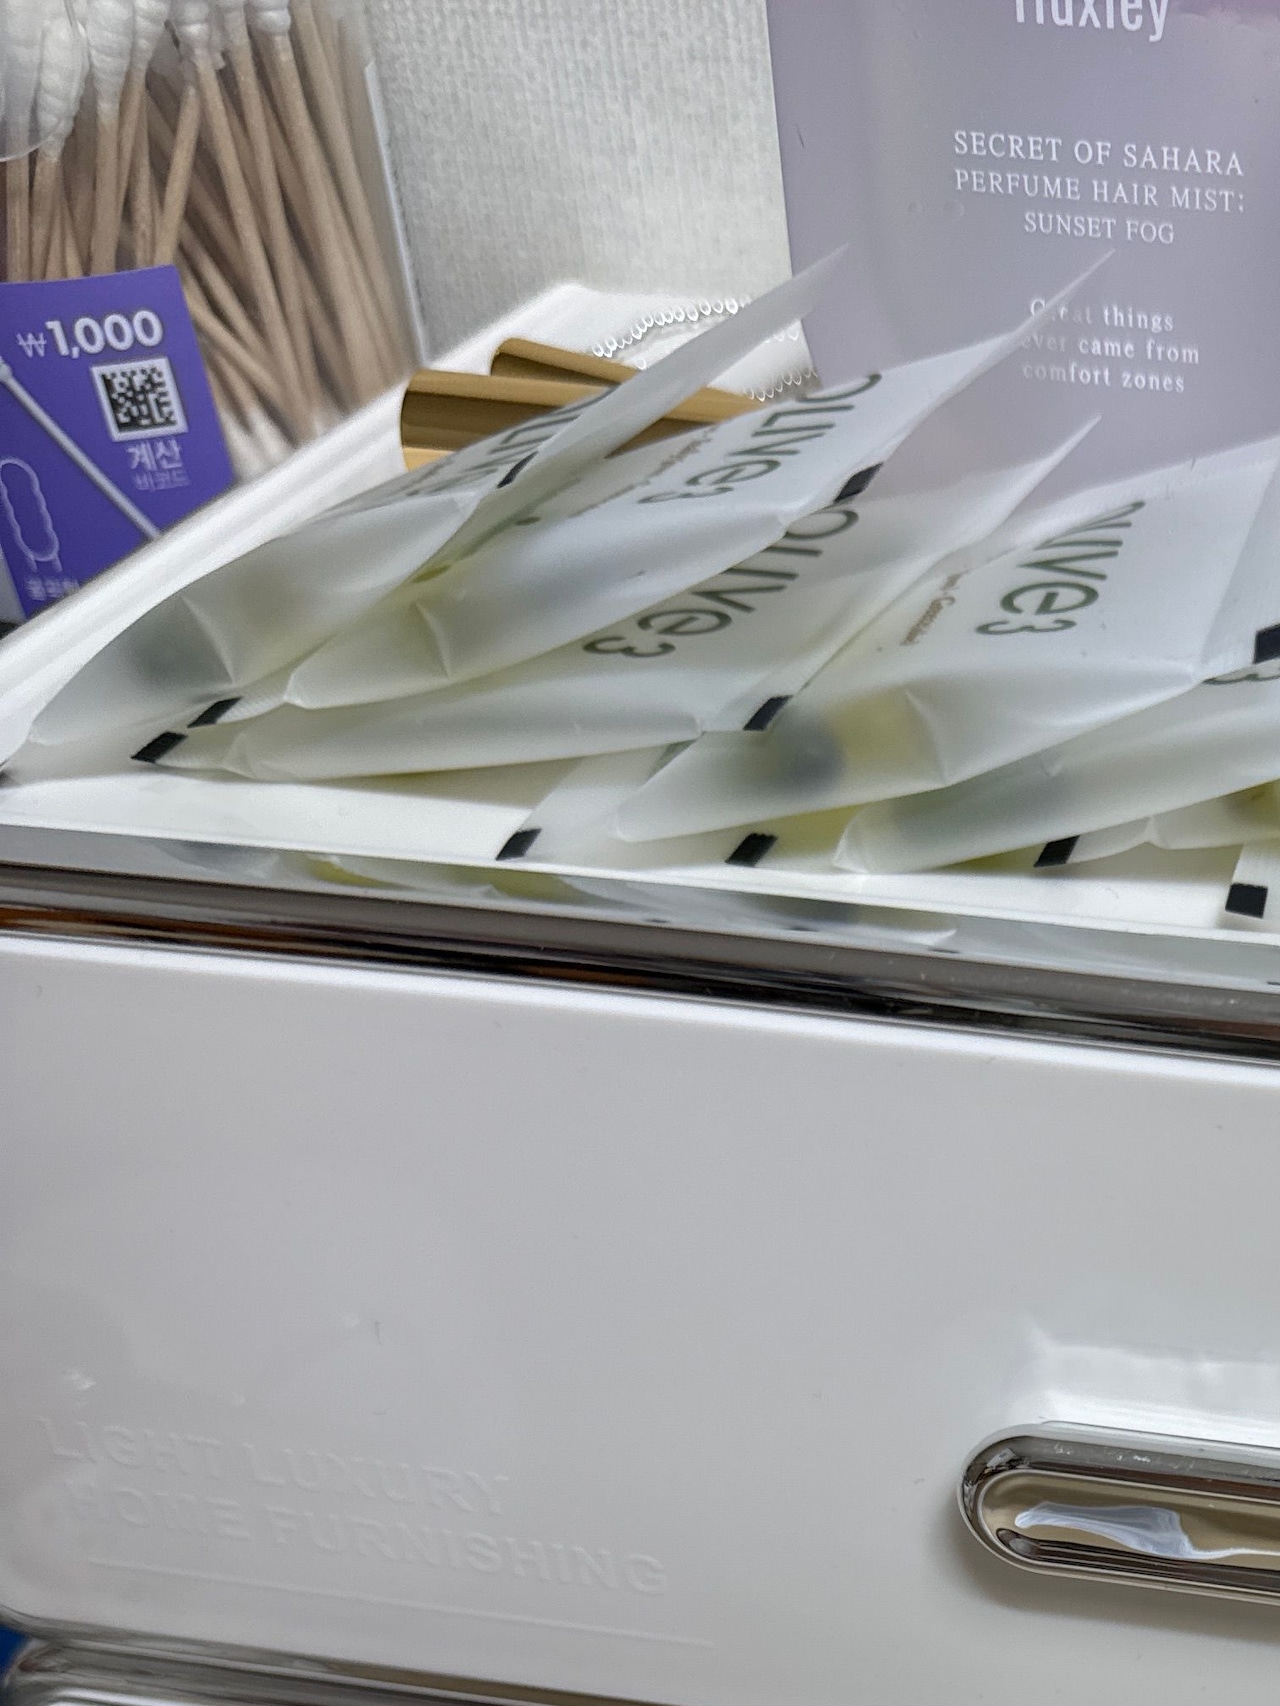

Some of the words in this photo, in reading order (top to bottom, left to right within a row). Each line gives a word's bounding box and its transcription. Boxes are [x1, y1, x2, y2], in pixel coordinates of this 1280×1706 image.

[954, 129, 1062, 162] SECRET
[1074, 140, 1111, 165] OF
[1123, 143, 1244, 176] SAHARA
[954, 168, 1081, 200] PERFUME
[1092, 179, 1158, 206] HAIR
[1024, 211, 1116, 239] SUNSET
[1126, 220, 1174, 244] FOG
[1103, 304, 1173, 333] things
[1079, 337, 1135, 359] came
[1147, 338, 1199, 365] from
[1023, 360, 1110, 387] comfort
[1121, 370, 1185, 394] zones
[126, 439, 183, 472] 계산
[243, 1441, 510, 1517] LUXURY
[264, 1502, 669, 1597] FURNISHING
